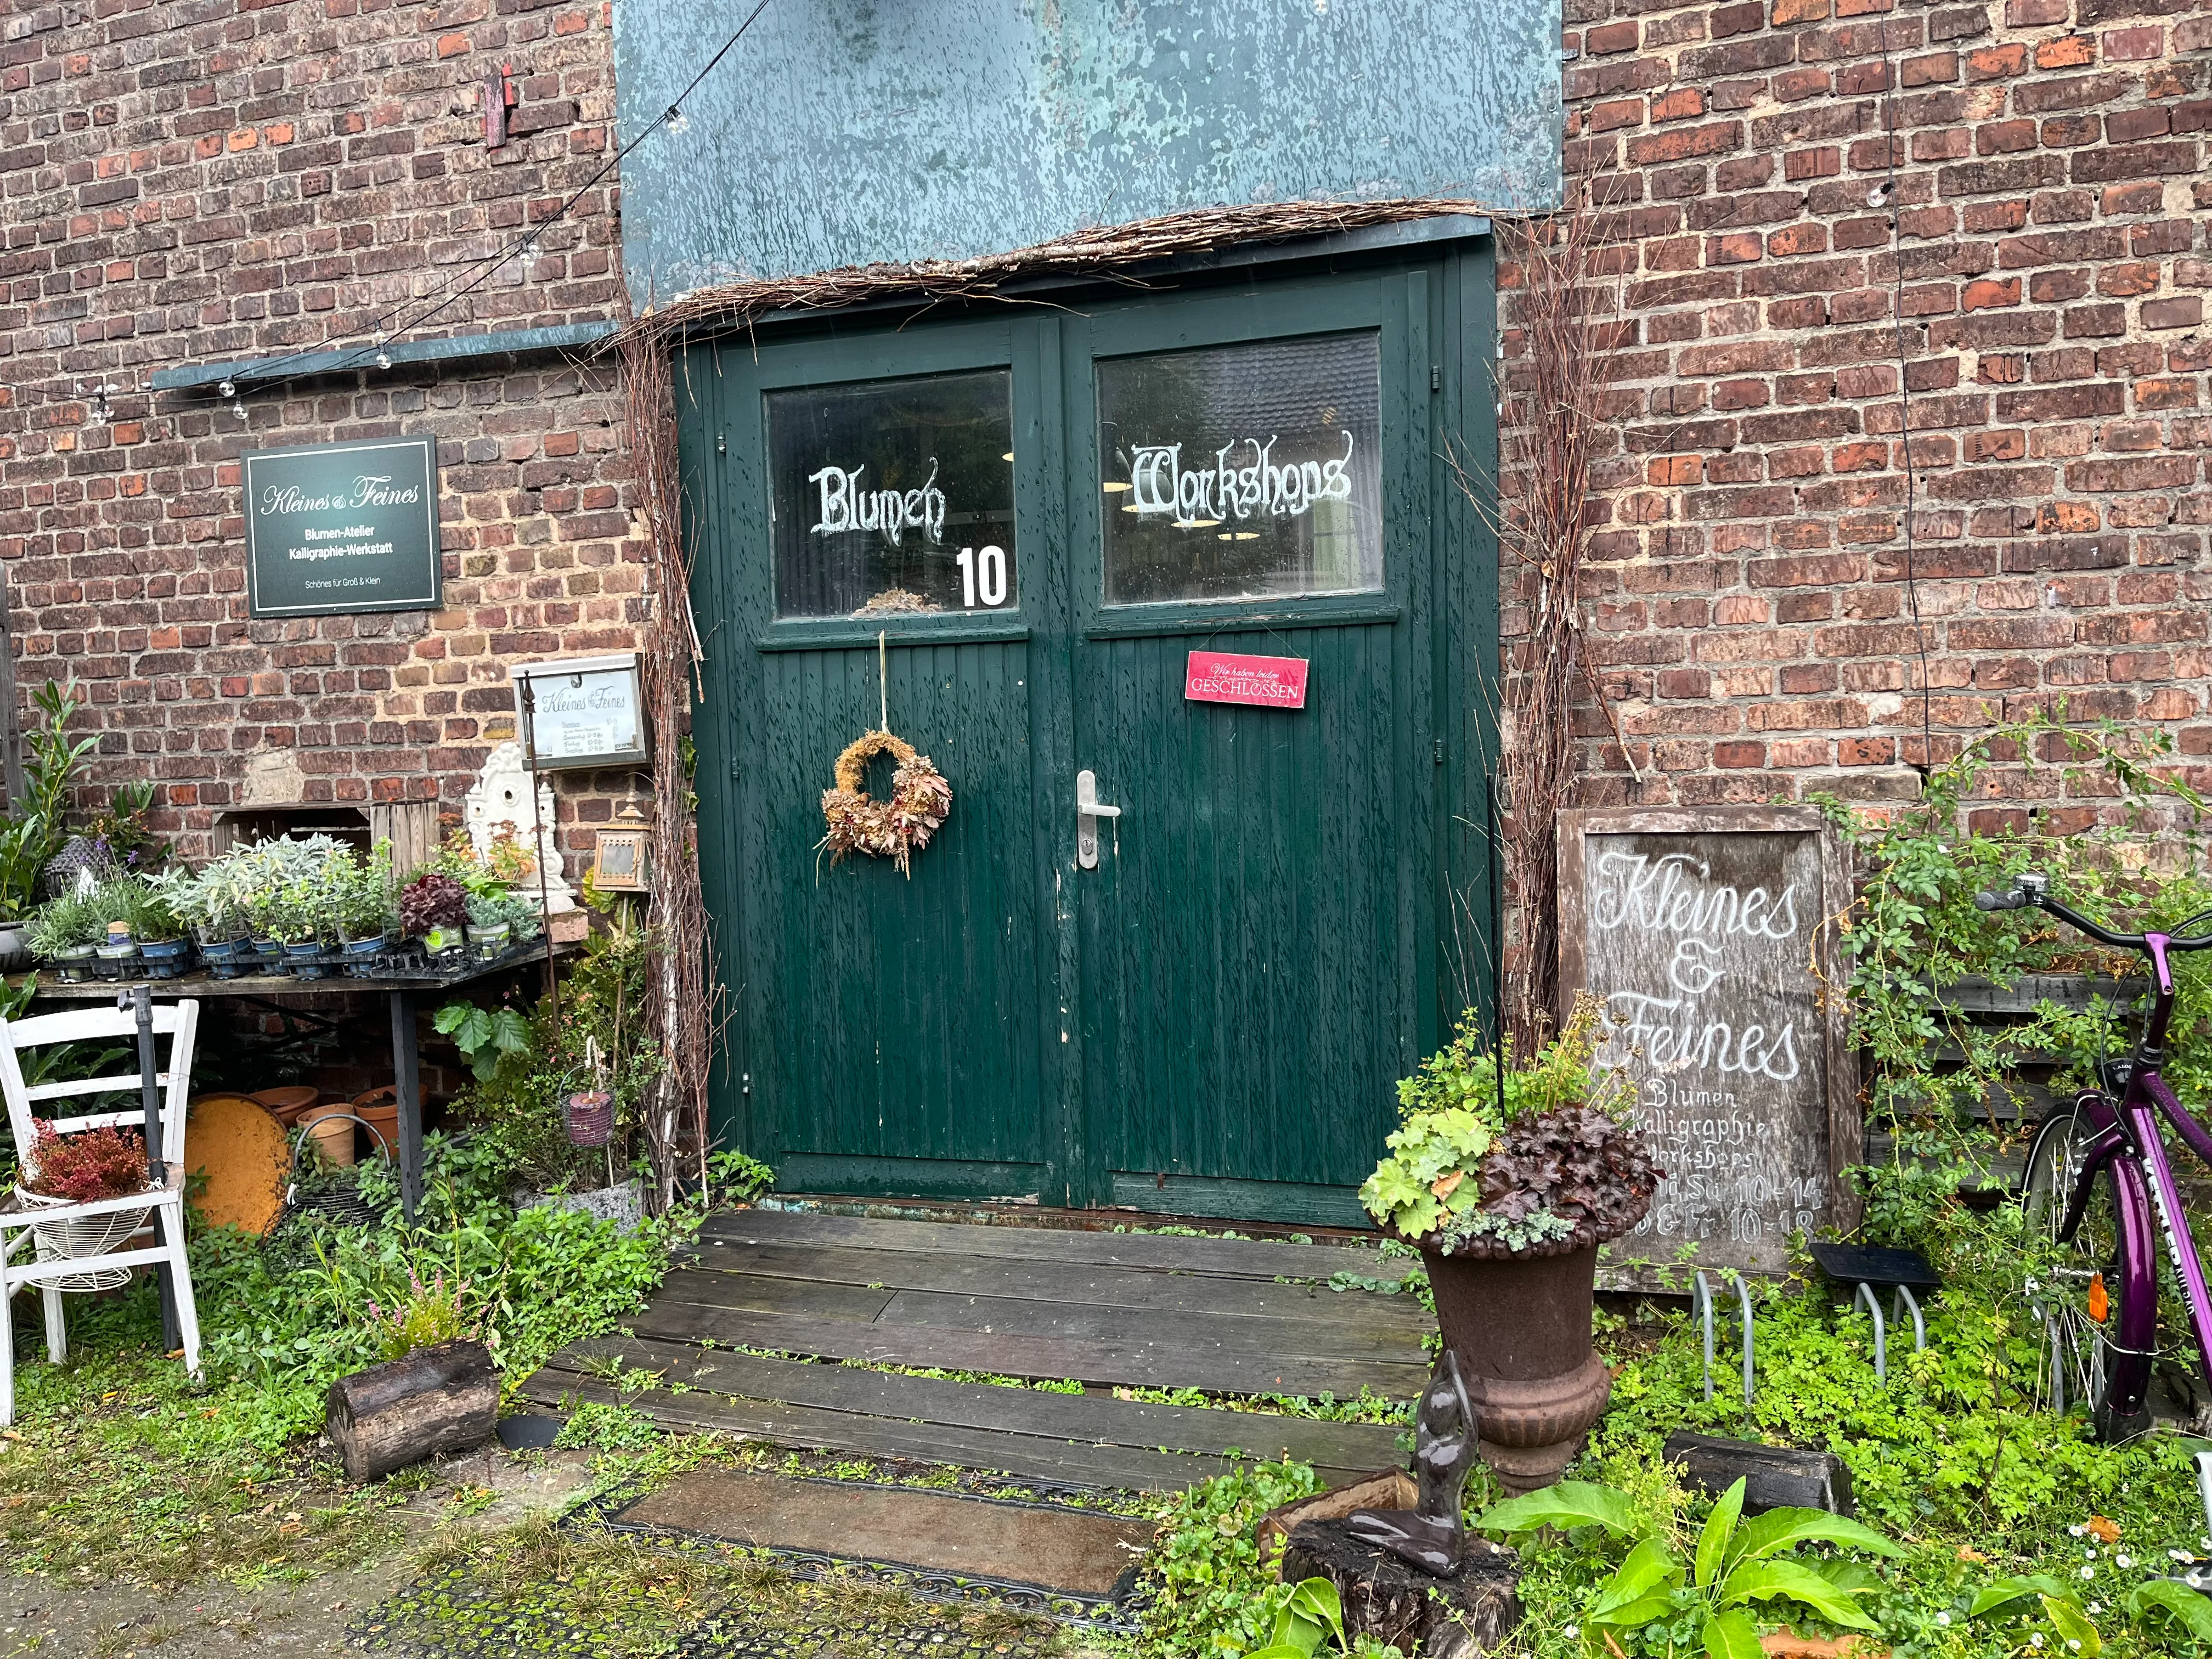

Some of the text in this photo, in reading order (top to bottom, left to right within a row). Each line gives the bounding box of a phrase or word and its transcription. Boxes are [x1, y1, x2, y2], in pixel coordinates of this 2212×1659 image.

[1131, 430, 1353, 526] Workshops
[261, 485, 330, 515] Kleines
[349, 475, 419, 509] Feines
[808, 456, 947, 548] Blumen
[304, 524, 375, 541] Blumen-Atelier
[289, 542, 393, 561] Kalligraphie-Werkstatt
[305, 579, 332, 589] Schönes
[332, 578, 342, 588] für
[342, 578, 358, 586] Groß
[365, 577, 380, 585] Klein
[956, 545, 1007, 607] 10
[1210, 663, 1279, 680] Wir haben leider
[542, 687, 586, 713] Kleines
[595, 686, 625, 709] Feines
[1191, 678, 1299, 699] GESCHLOSSEN
[1595, 851, 1797, 939] Kleines
[1671, 937, 1726, 994] &
[1594, 990, 1799, 1080] Feines
[1645, 1079, 1739, 1108] Blumen
[1687, 1175, 1725, 1202] Sa
[1657, 1203, 1682, 1236] &
[1684, 1203, 1715, 1239] Fr
